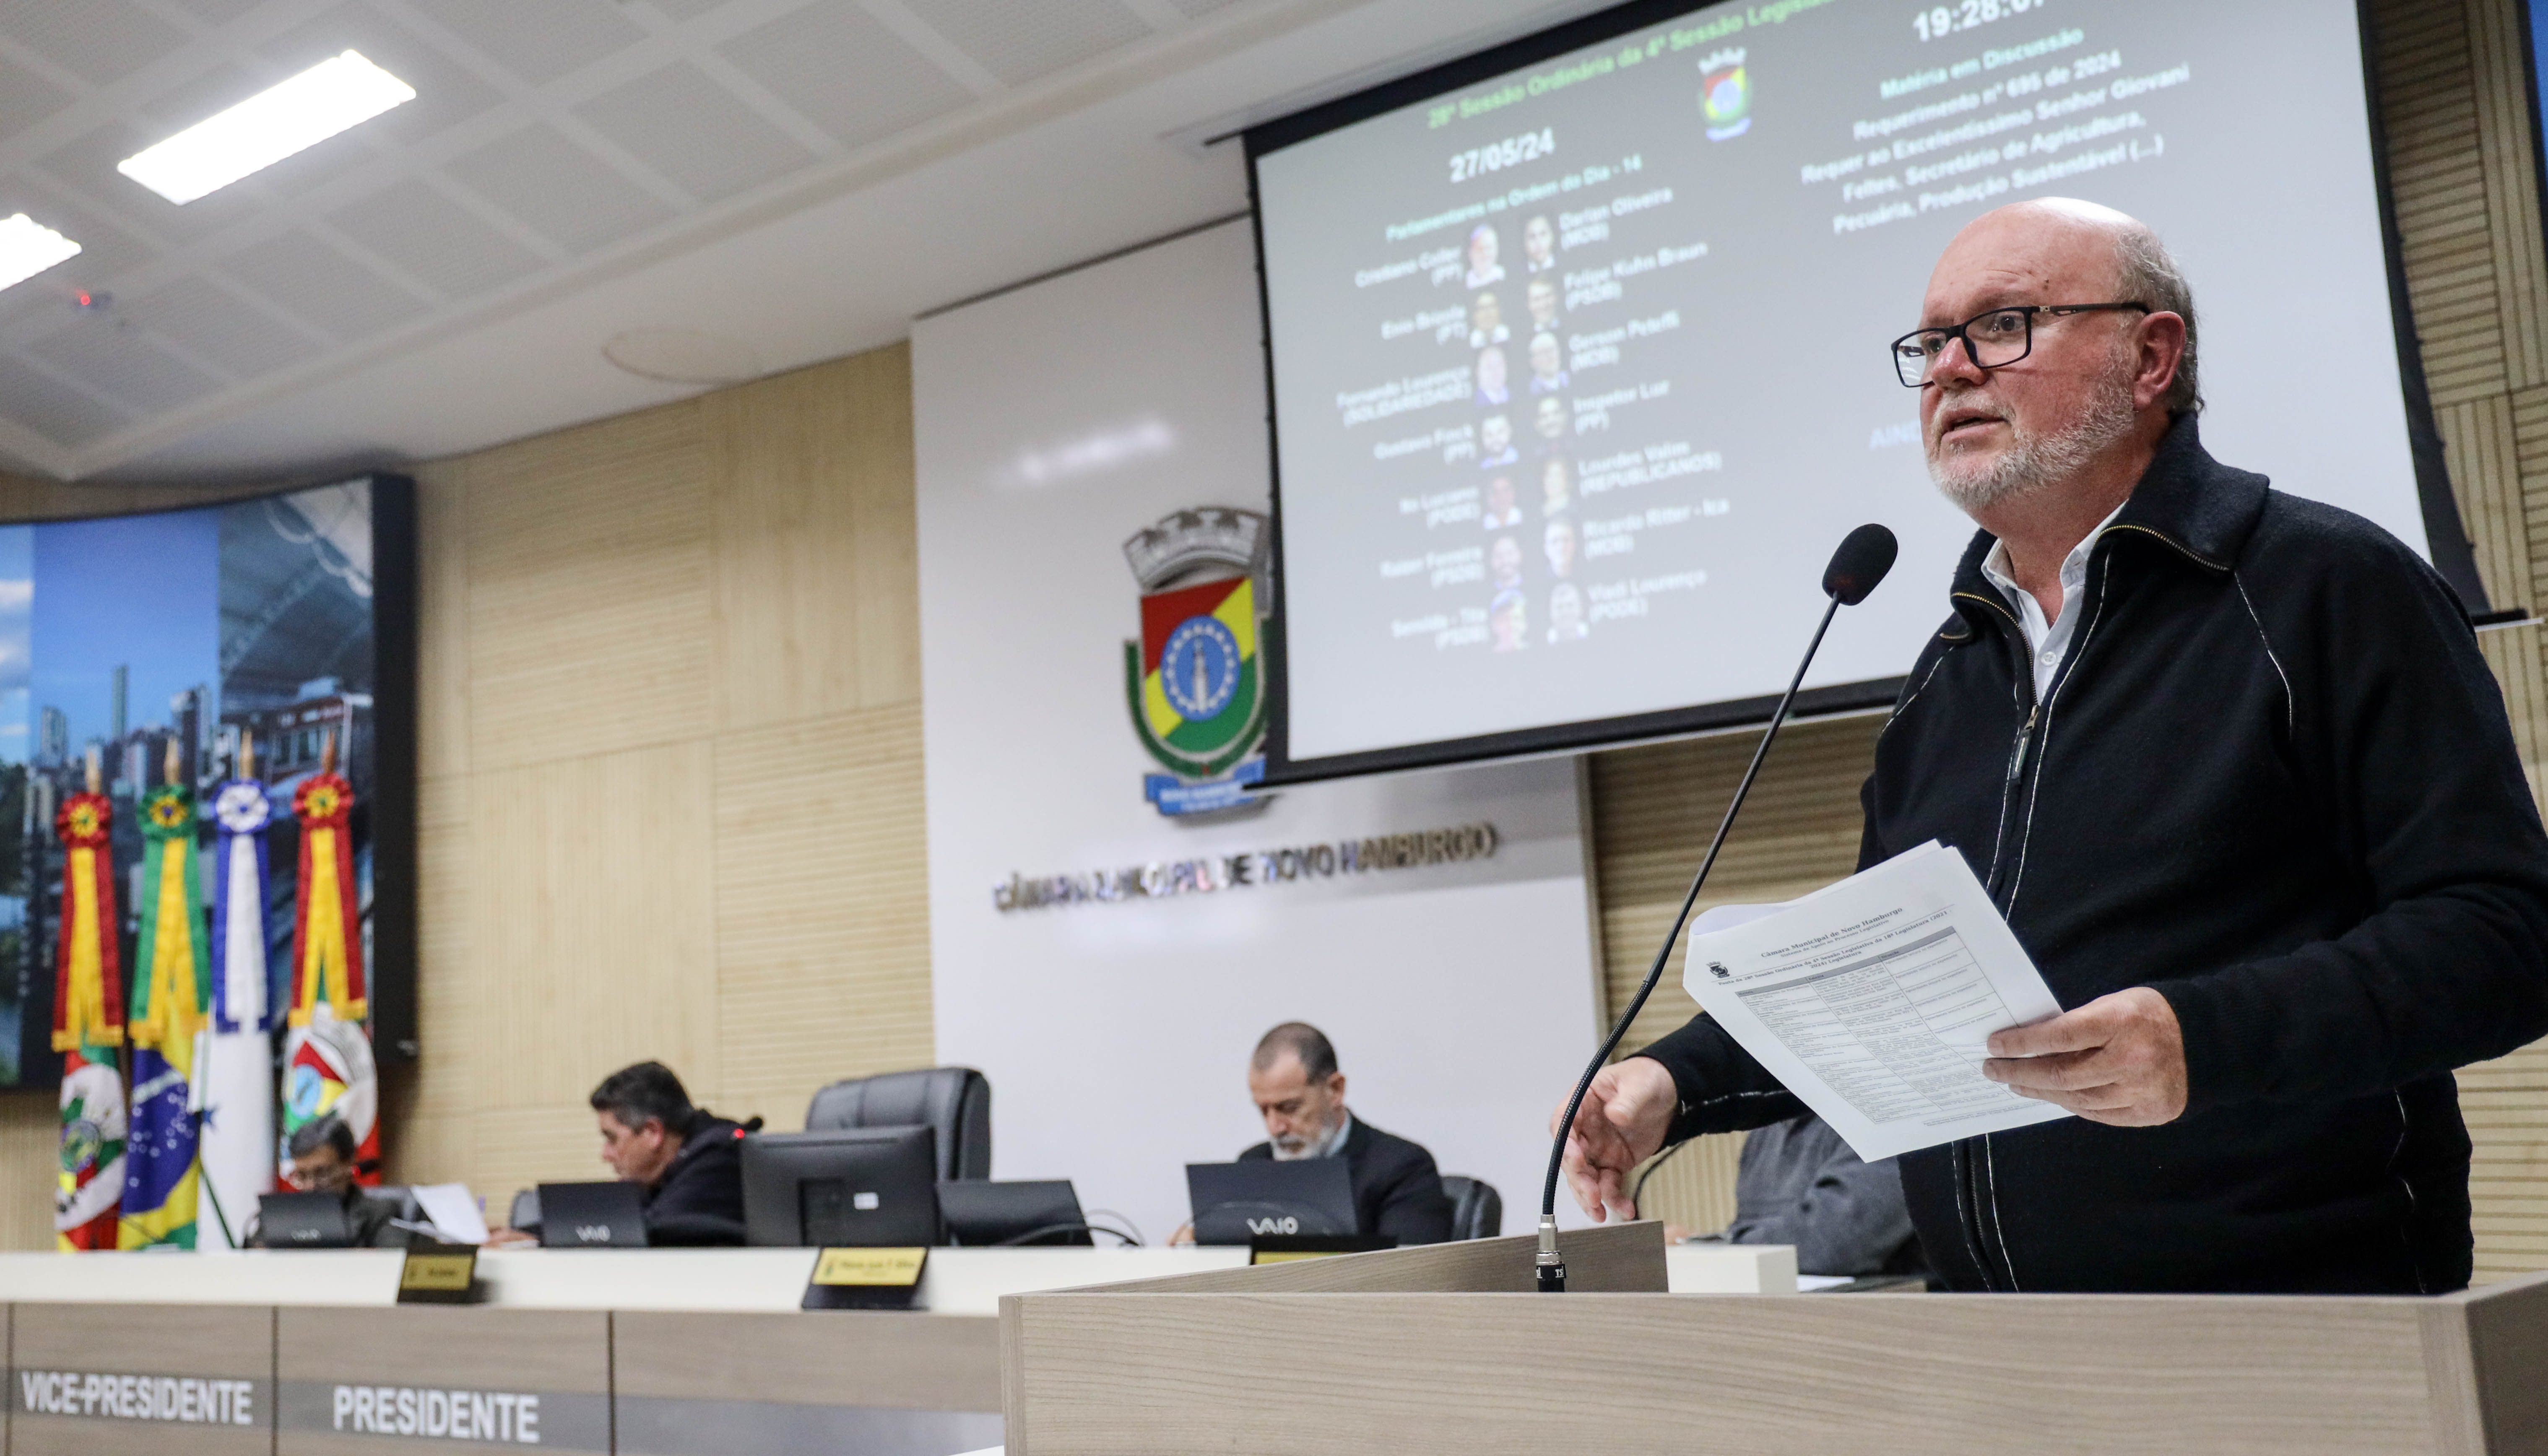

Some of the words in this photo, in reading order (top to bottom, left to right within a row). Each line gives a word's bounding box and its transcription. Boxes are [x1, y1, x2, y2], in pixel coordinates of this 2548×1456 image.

[1913, 0, 2044, 42] 19:28:
[1459, 85, 1526, 119] Sessão
[1527, 55, 1615, 96] Ordinária
[1617, 47, 1643, 68] da
[1669, 15, 1745, 51] Sessão
[1880, 67, 1948, 99] Matéria
[1950, 58, 1981, 80] em
[1983, 28, 2084, 70] Discussão
[1854, 93, 1980, 141] Requerimento
[2045, 66, 2070, 87] de
[2074, 49, 2122, 80] 2024
[1802, 154, 1864, 184] Requer
[1867, 148, 1891, 167] ao
[2036, 88, 2107, 120] Senhor
[2111, 61, 2190, 99] Giovani
[1449, 126, 1555, 183] 27/05/24
[1583, 166, 1610, 185] Dia
[1906, 148, 2000, 186] Secretário
[2002, 140, 2028, 161] de
[1919, 176, 2009, 213] Produção
[2012, 142, 2127, 189] Sustentável
[1761, 946, 1789, 958] Câmara
[1791, 934, 1828, 950] Municipal
[1830, 930, 1839, 939] de
[1841, 924, 1860, 934] Novo
[1862, 907, 1903, 926] Hamburgo
[1775, 962, 1803, 973] Ordinária
[1820, 952, 1840, 961] Sessão
[1841, 940, 1873, 954] Legislativa
[1895, 920, 1929, 936] Legislatura
[1860, 920, 1889, 933] Legislativo
[1828, 951, 1862, 964] Legislatura
[1246, 1217, 1299, 1235] VAIO
[21, 1370, 253, 1425] VICE-PRESIDENTE
[334, 1385, 541, 1443] PRESIDENTE
